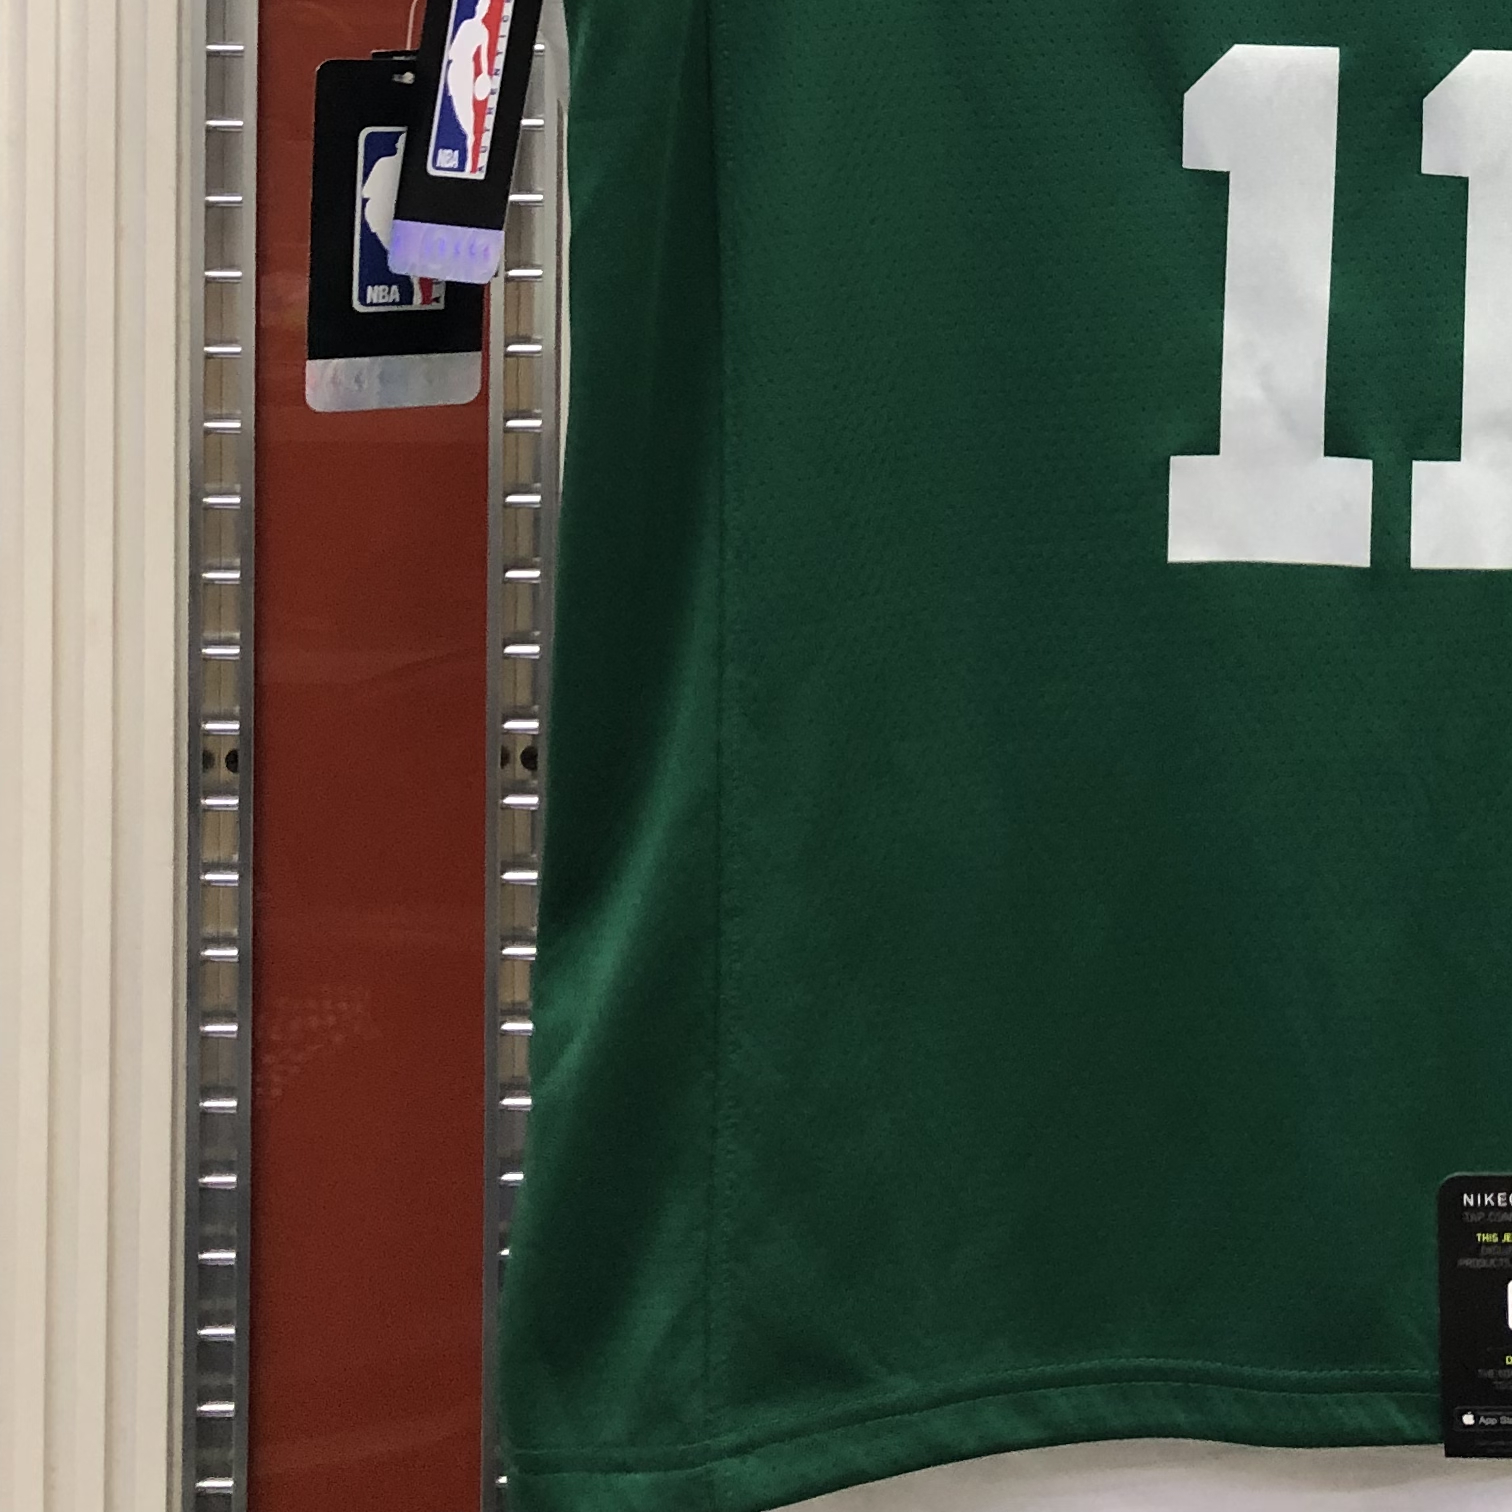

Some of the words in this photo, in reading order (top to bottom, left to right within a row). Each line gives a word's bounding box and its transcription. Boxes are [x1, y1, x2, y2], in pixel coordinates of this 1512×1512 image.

[366, 285, 400, 304] NBA
[1476, 1233, 1498, 1243] THIS
[1478, 1416, 1497, 1426] App
